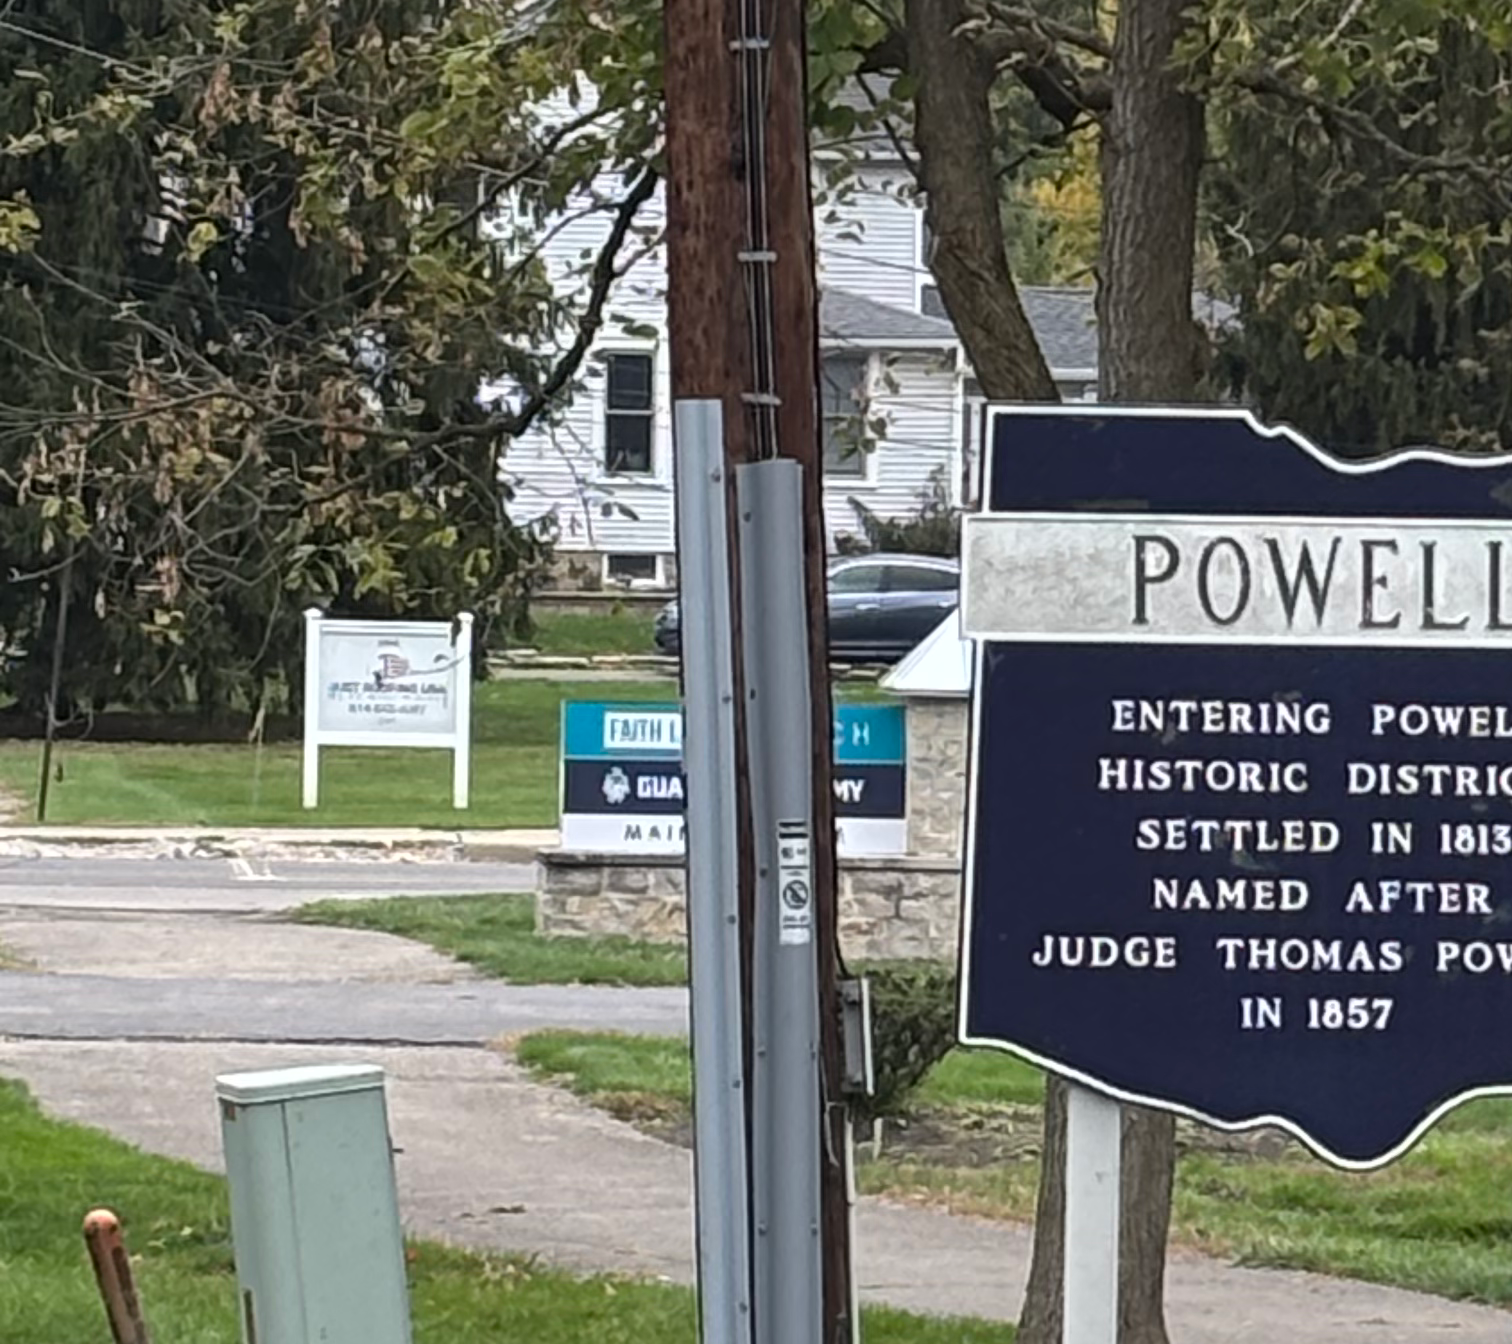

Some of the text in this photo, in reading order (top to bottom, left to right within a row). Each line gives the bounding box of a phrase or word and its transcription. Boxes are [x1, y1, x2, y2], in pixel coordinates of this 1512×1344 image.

[609, 717, 662, 744] FAITH
[1112, 699, 1331, 735] ENTERING
[1098, 758, 1308, 793] HISTORIC
[1136, 818, 1512, 855] SETTLED IN 1813
[1153, 878, 1494, 914] NAMED AFTER
[1032, 934, 1177, 968] JUDGE
[1216, 938, 1403, 972] THOMAS
[1241, 997, 1393, 1030] IN 1857
